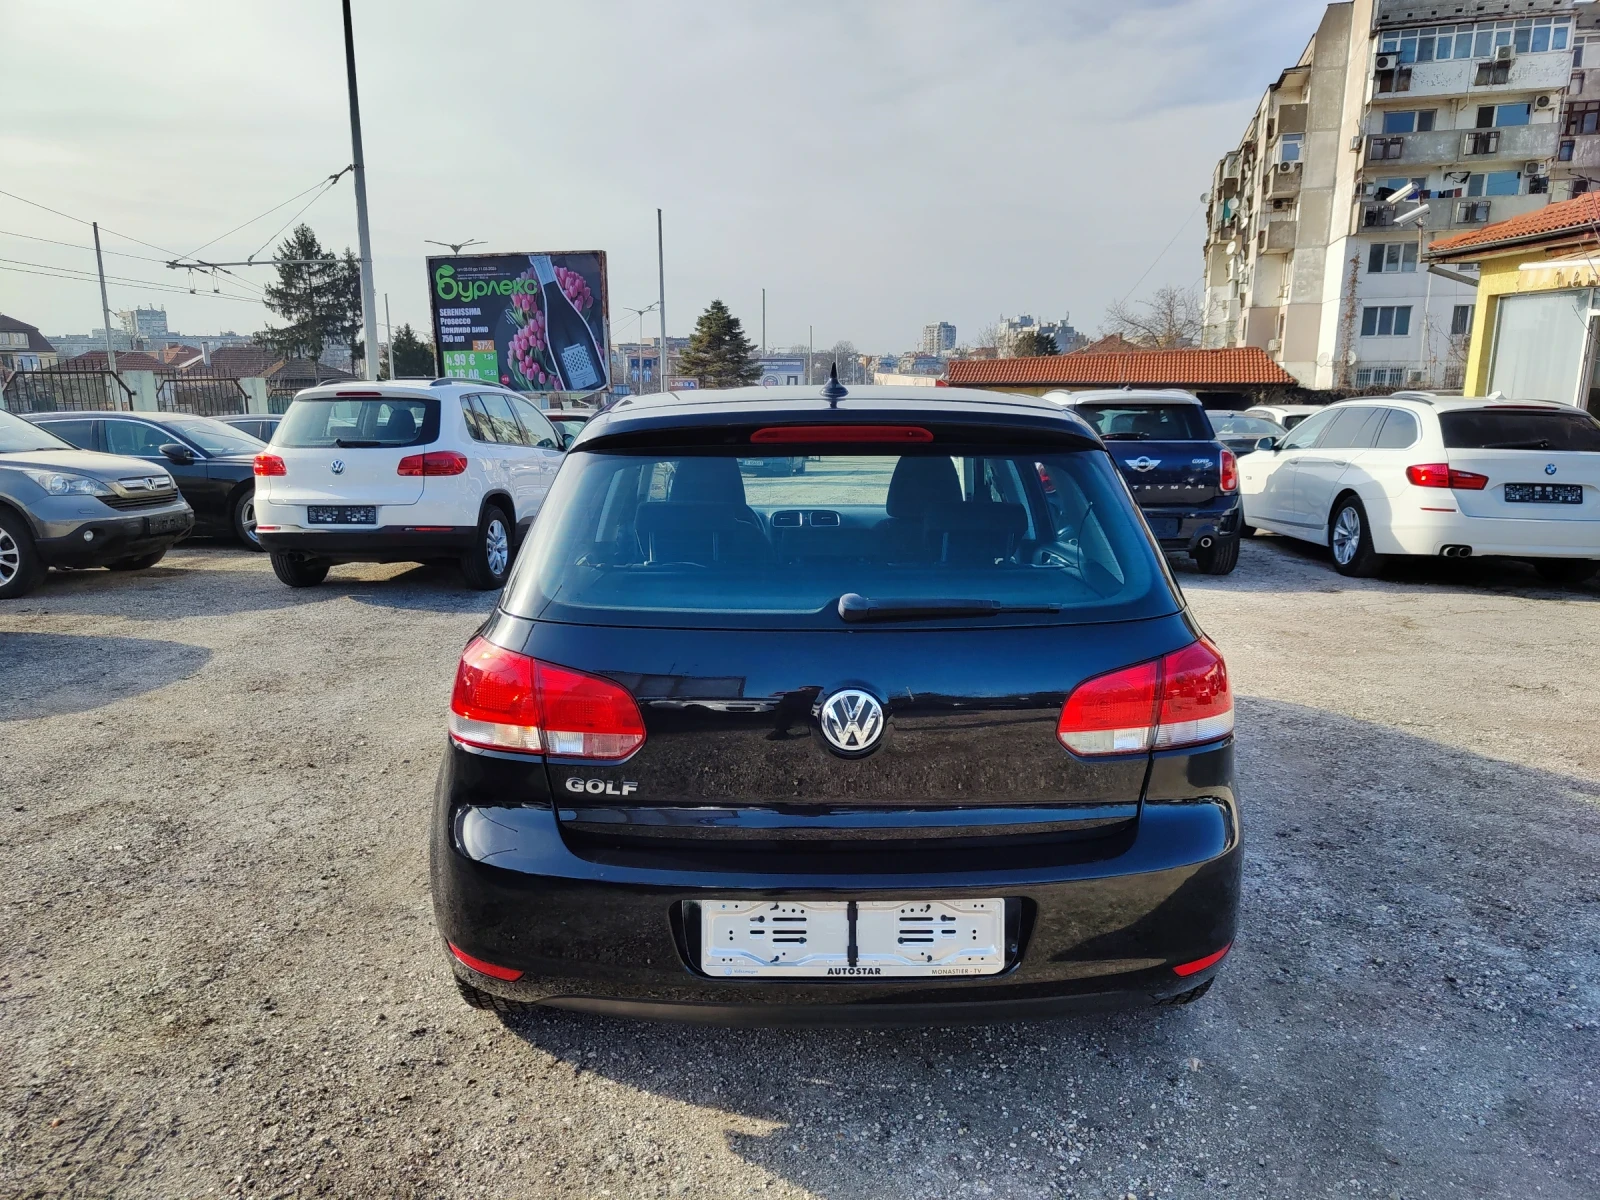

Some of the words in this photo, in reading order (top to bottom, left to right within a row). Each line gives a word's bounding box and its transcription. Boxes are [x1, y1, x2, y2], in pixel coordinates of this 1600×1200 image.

[440, 307, 481, 316] SERENISSIMA
[440, 317, 471, 325] Prosecco
[441, 326, 471, 334] Пенливо
[442, 335, 454, 343] 750
[474, 341, 492, 350] -37%
[446, 353, 466, 366] 4.99
[468, 353, 476, 366] €
[821, 689, 884, 751] VW
[565, 777, 638, 795] GOLF
[827, 967, 881, 975] AUTOSTAR
